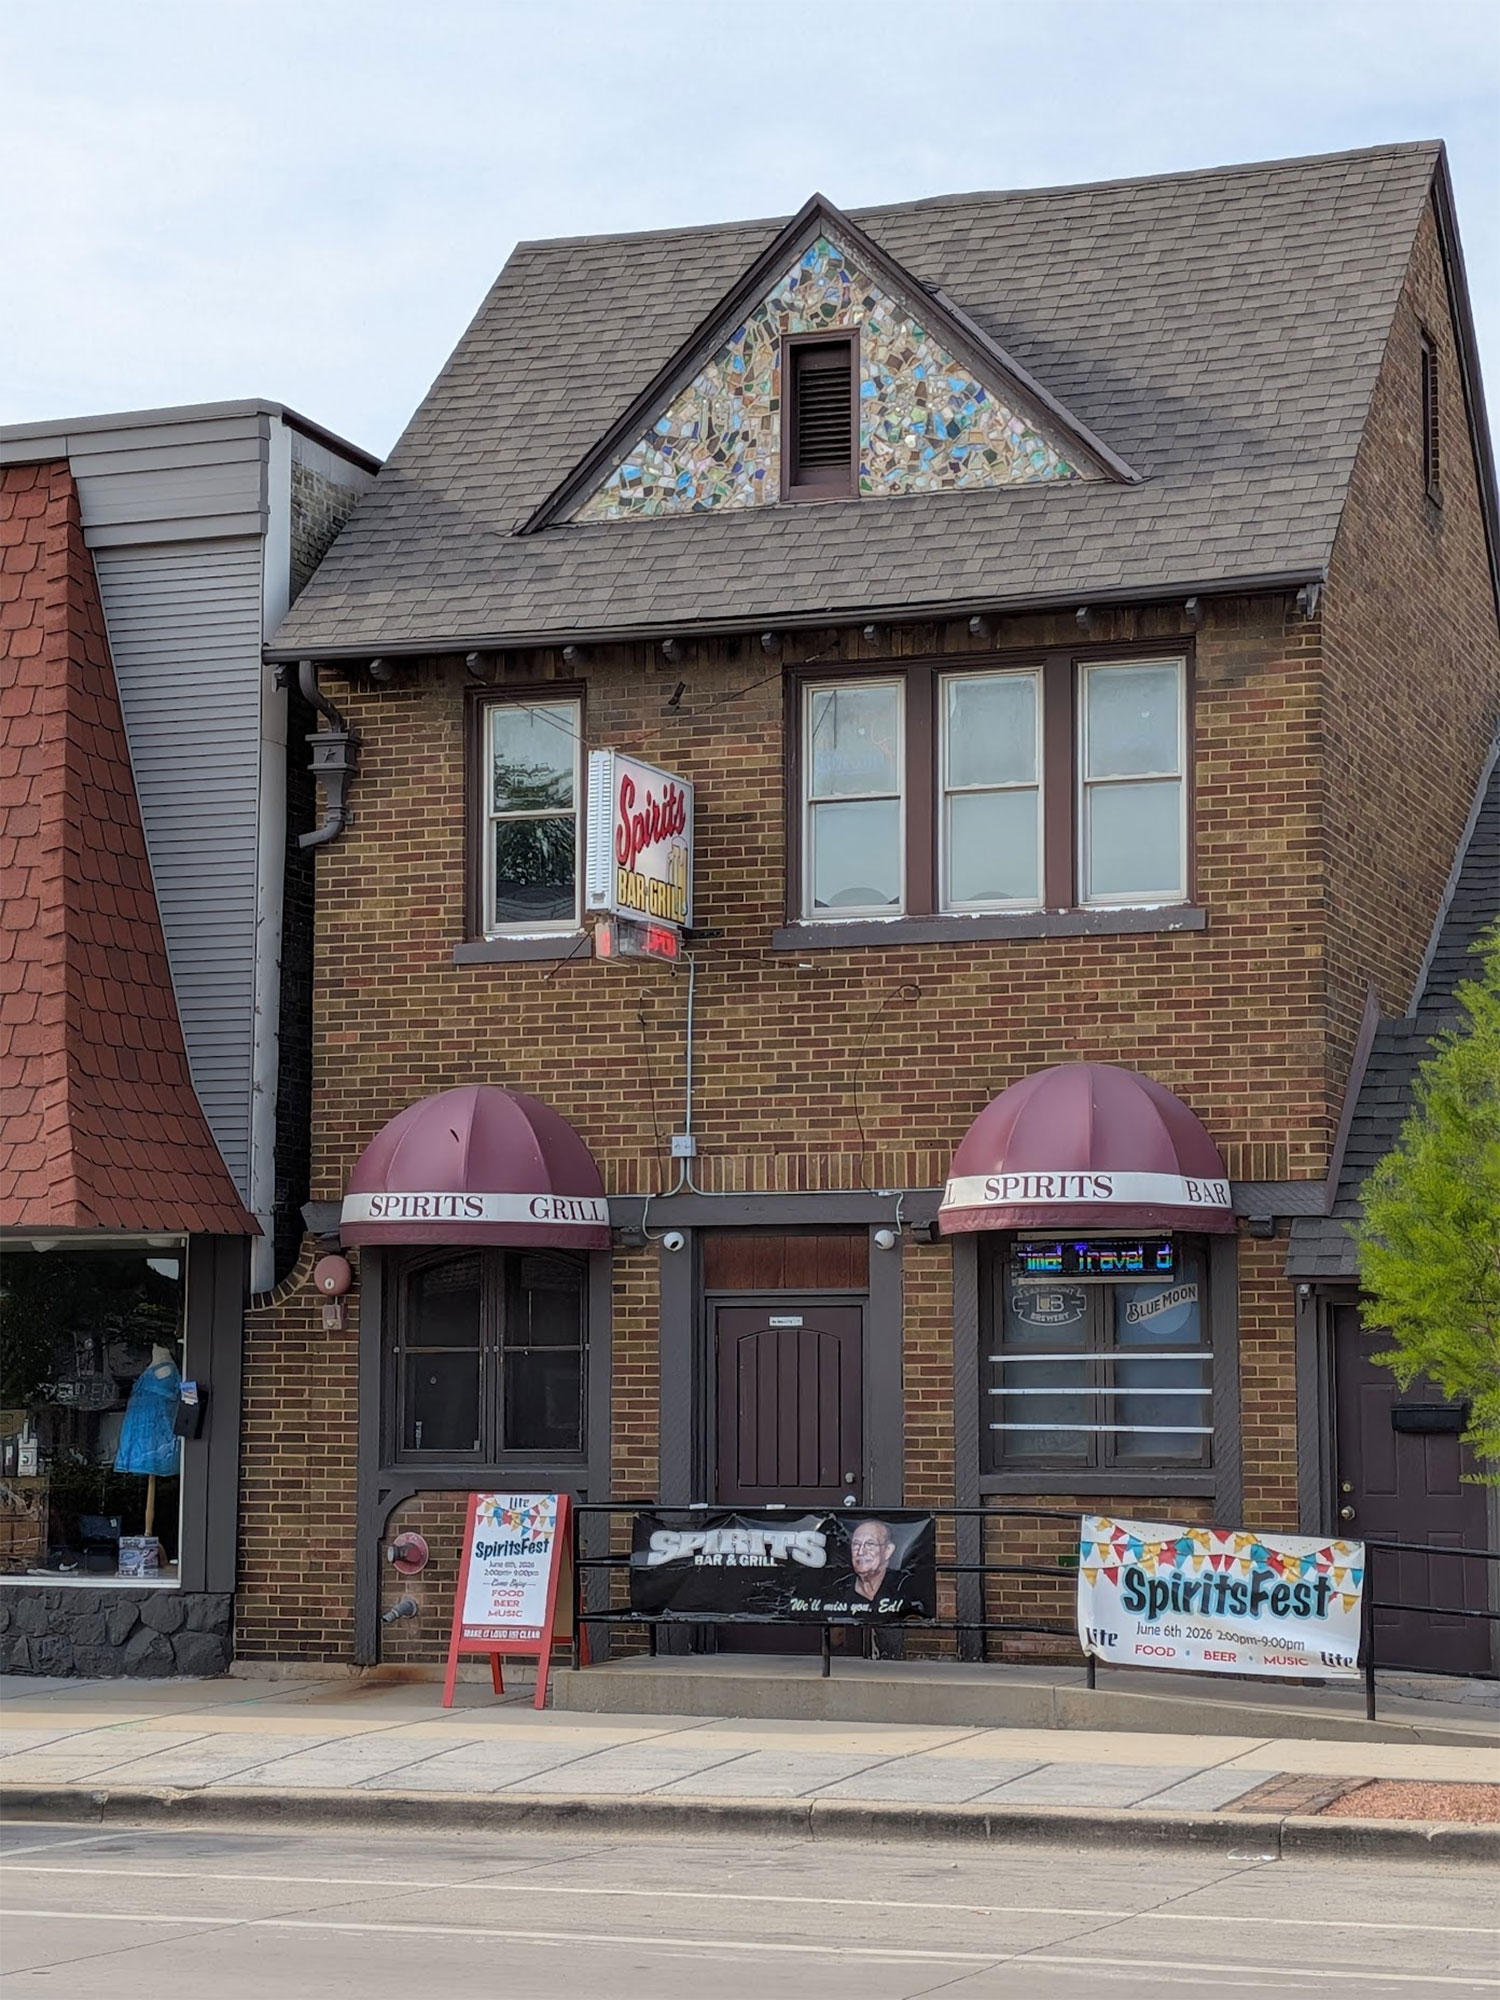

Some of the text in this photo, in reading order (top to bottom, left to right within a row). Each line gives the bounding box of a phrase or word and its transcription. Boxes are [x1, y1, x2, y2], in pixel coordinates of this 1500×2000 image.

[616, 774, 685, 872] Spirits
[617, 867, 685, 925] BAR GRILL
[983, 1175, 1228, 1205] SPIRITS BAR
[369, 1195, 605, 1222] SPIRITS GRILL
[1074, 1243, 1143, 1270] Travel
[1127, 1286, 1196, 1323] BLUE MOON
[509, 1497, 530, 1511] Lite
[475, 1537, 550, 1561] SpiritsFest
[647, 1528, 828, 1568] SPIRITS
[694, 1554, 778, 1568] BAR & GRILL
[491, 1589, 525, 1597] FOOD
[1122, 1567, 1331, 1619] SpiritsFest
[488, 1610, 524, 1618] MUSIC
[790, 1598, 821, 1611] We'll
[823, 1600, 848, 1611] miss
[878, 1598, 904, 1613] Ed!
[1085, 1626, 1118, 1648] Lite
[1136, 1621, 1161, 1636] June
[1163, 1624, 1182, 1638] 6th
[1186, 1626, 1213, 1640] 2026
[1135, 1644, 1309, 1666] FOOD BEER MUSIC
[1320, 1651, 1354, 1668] Lite
